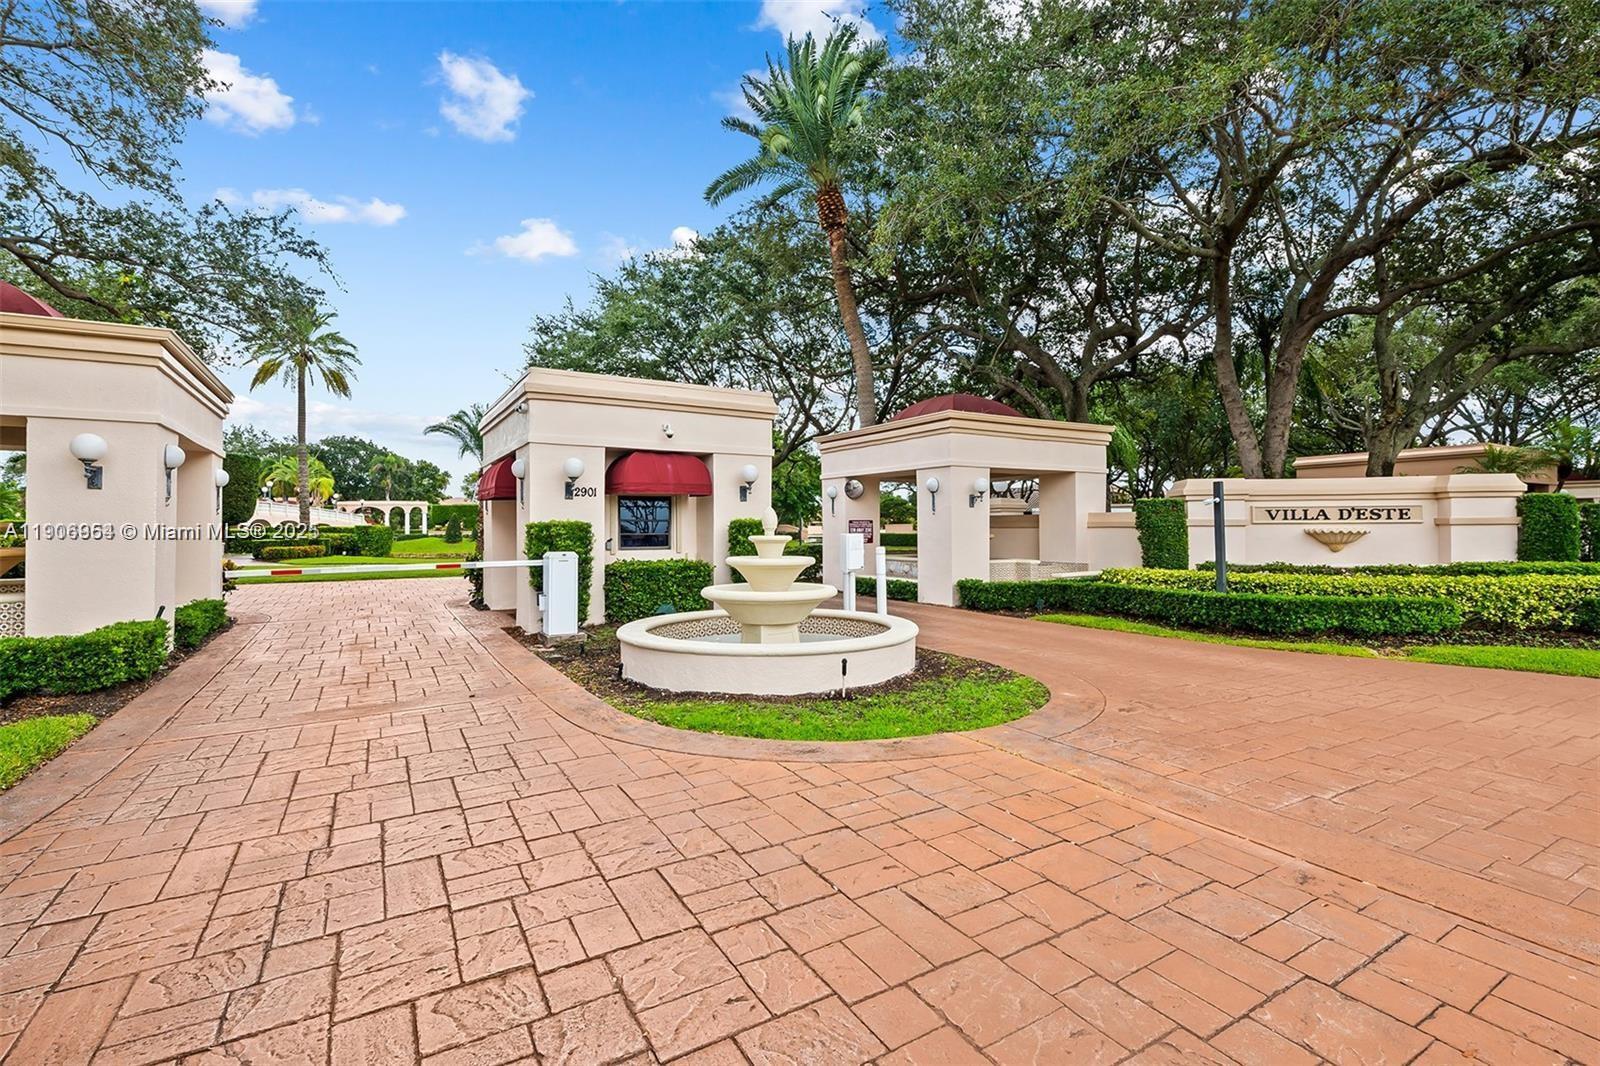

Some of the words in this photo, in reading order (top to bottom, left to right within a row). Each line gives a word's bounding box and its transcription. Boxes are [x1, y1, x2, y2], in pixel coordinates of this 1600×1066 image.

[574, 486, 597, 498] 2901
[1265, 509, 1330, 521] VILLA
[1339, 507, 1412, 520] D'ESTE
